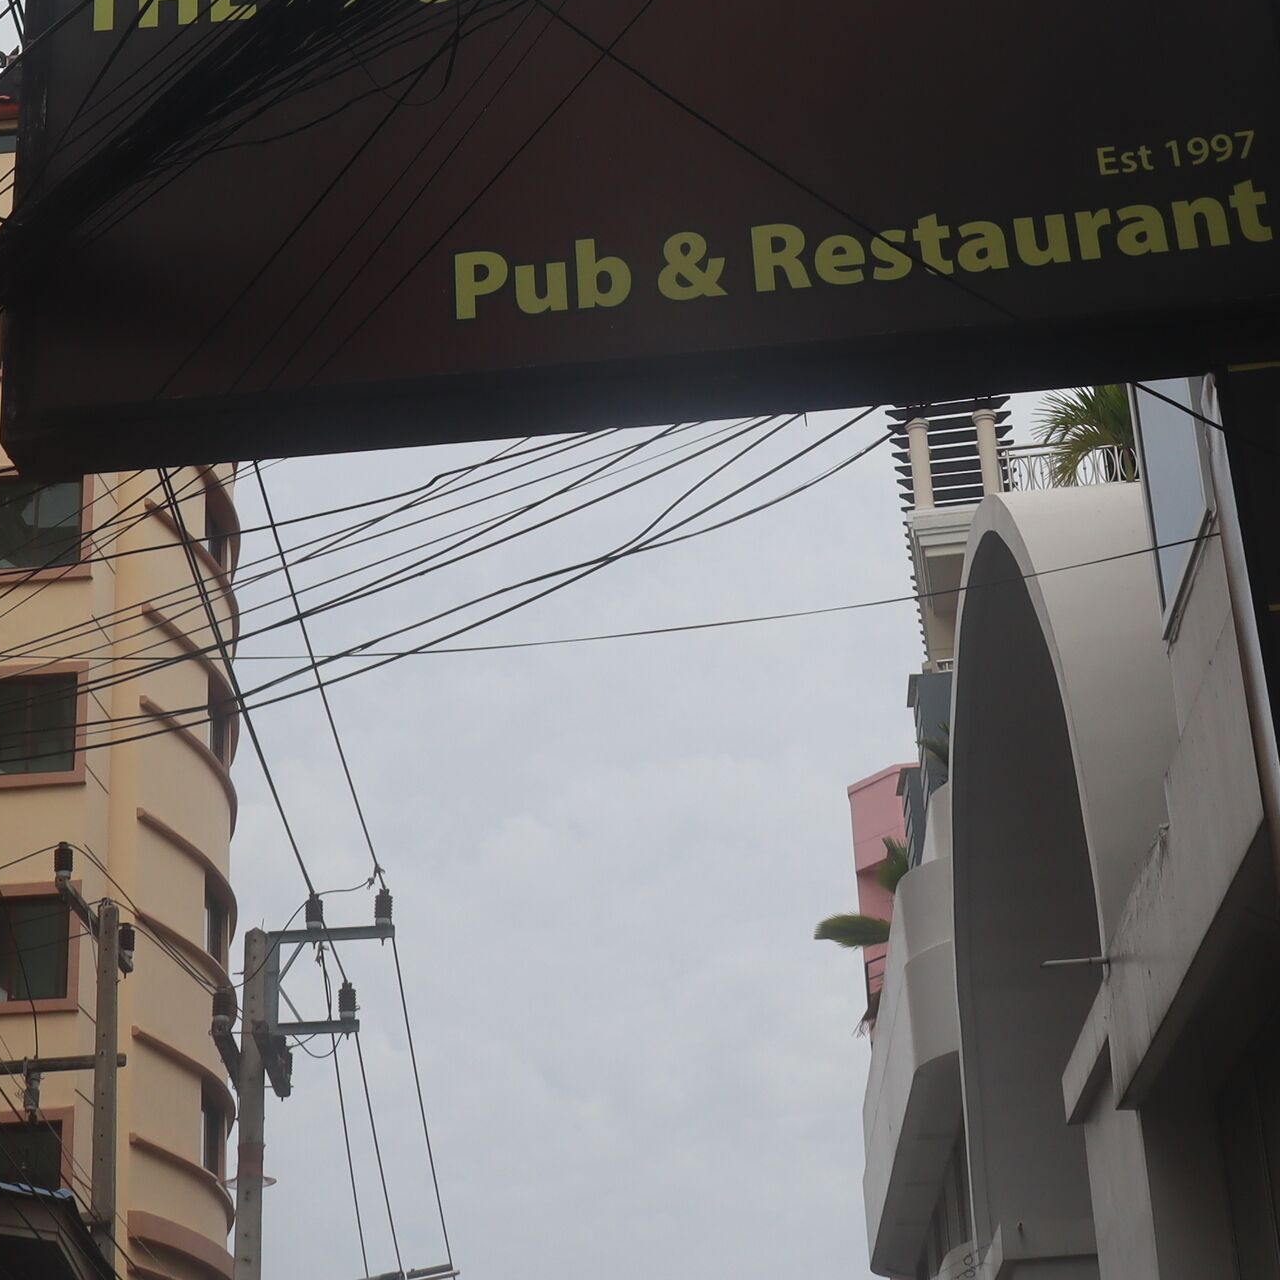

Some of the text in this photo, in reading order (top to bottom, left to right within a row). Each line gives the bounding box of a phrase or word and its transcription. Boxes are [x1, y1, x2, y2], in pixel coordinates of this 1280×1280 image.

[1096, 130, 1257, 176] Est 1997
[454, 179, 1273, 320] Pub & Restaurant
